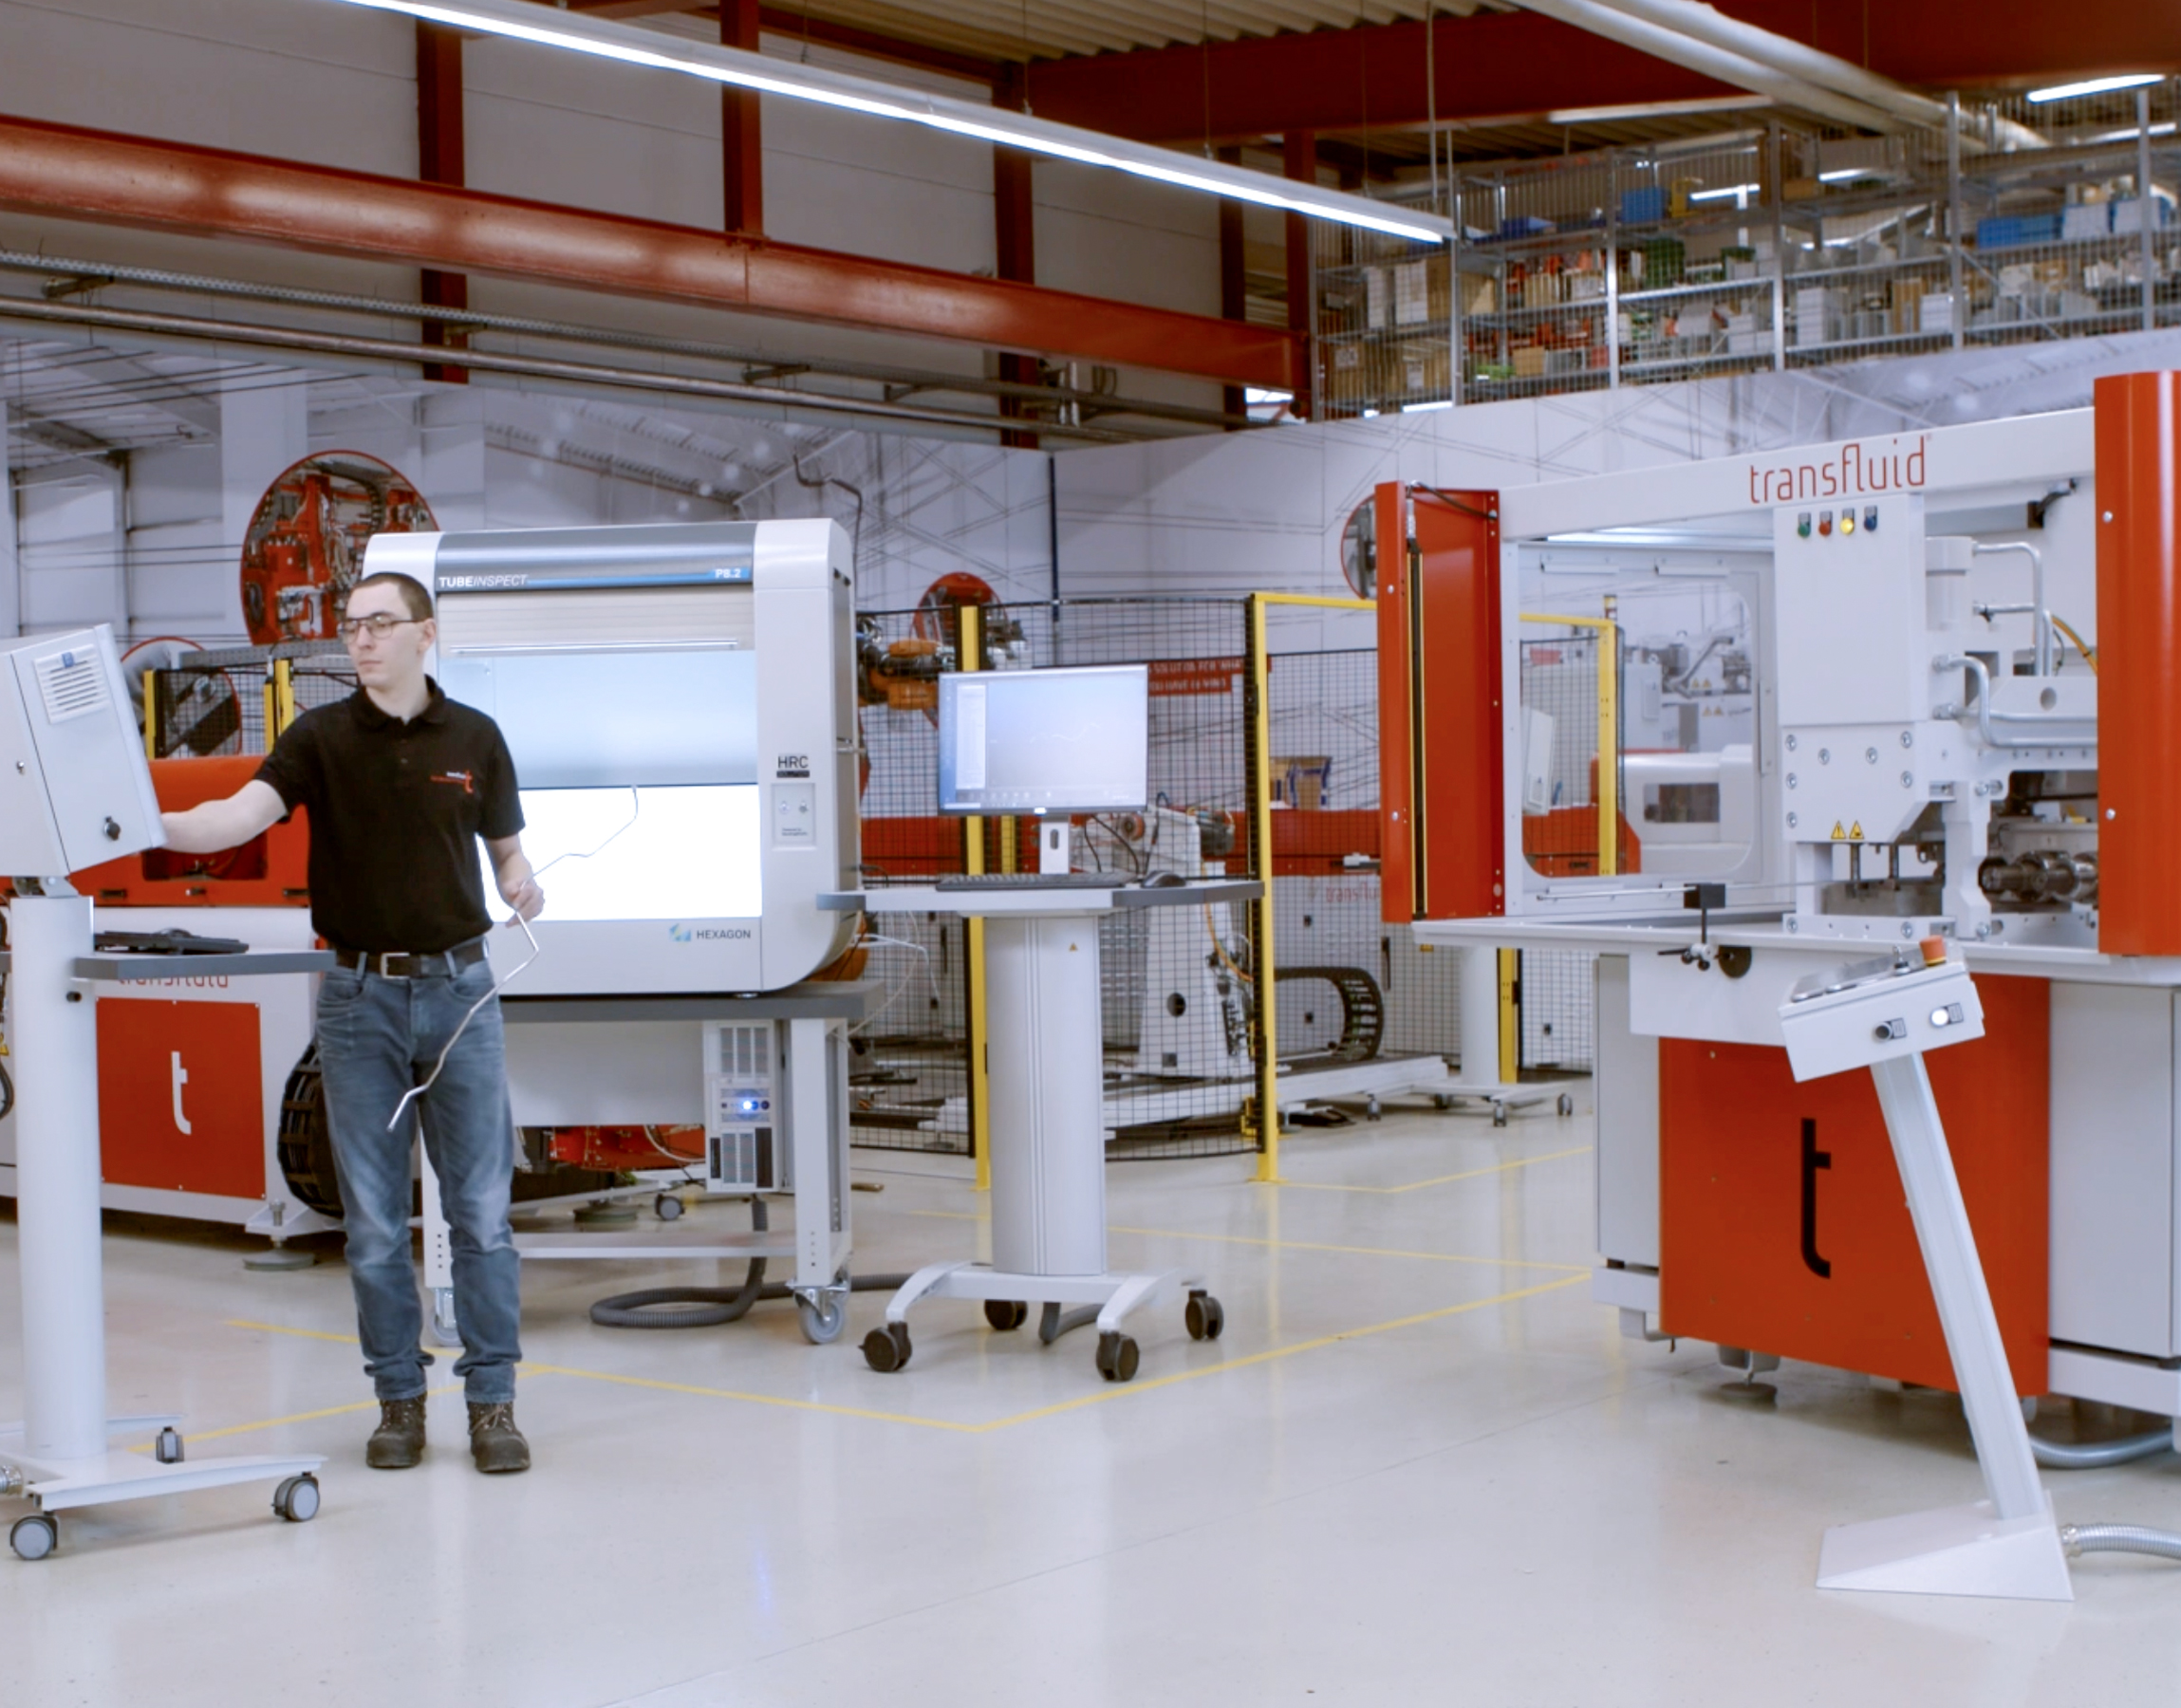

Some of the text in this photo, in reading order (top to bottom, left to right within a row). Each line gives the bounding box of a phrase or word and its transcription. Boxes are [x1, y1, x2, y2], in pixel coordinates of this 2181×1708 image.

[1749, 434, 1926, 504] transfluid
[438, 574, 529, 587] TUBEINSPECT
[777, 755, 809, 769] HRC
[697, 929, 752, 939] HEXAGON
[171, 1050, 192, 1136] t
